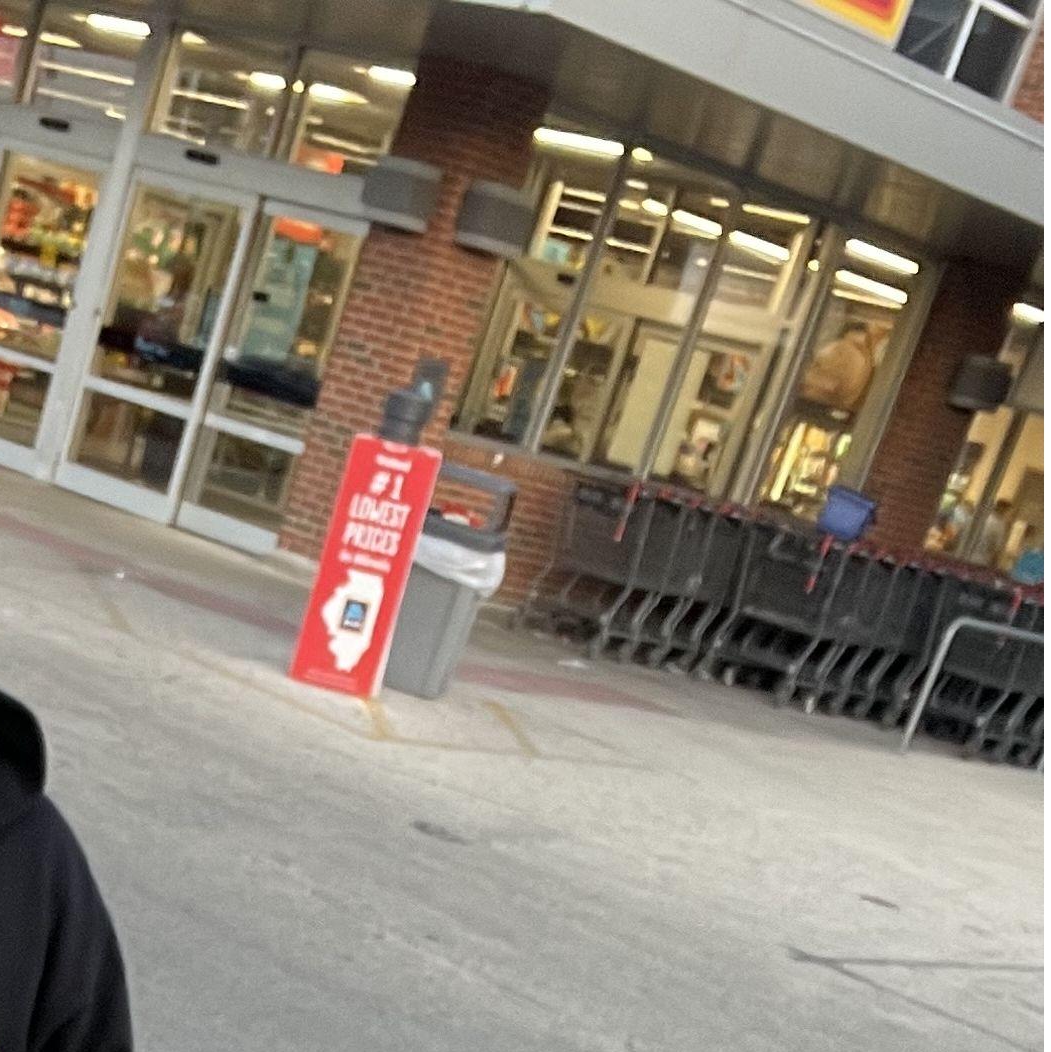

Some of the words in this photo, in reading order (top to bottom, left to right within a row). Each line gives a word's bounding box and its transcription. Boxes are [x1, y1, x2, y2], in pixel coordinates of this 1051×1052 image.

[369, 470, 404, 501] #1
[348, 492, 411, 532] LOWEST
[341, 521, 402, 557] PRICES
